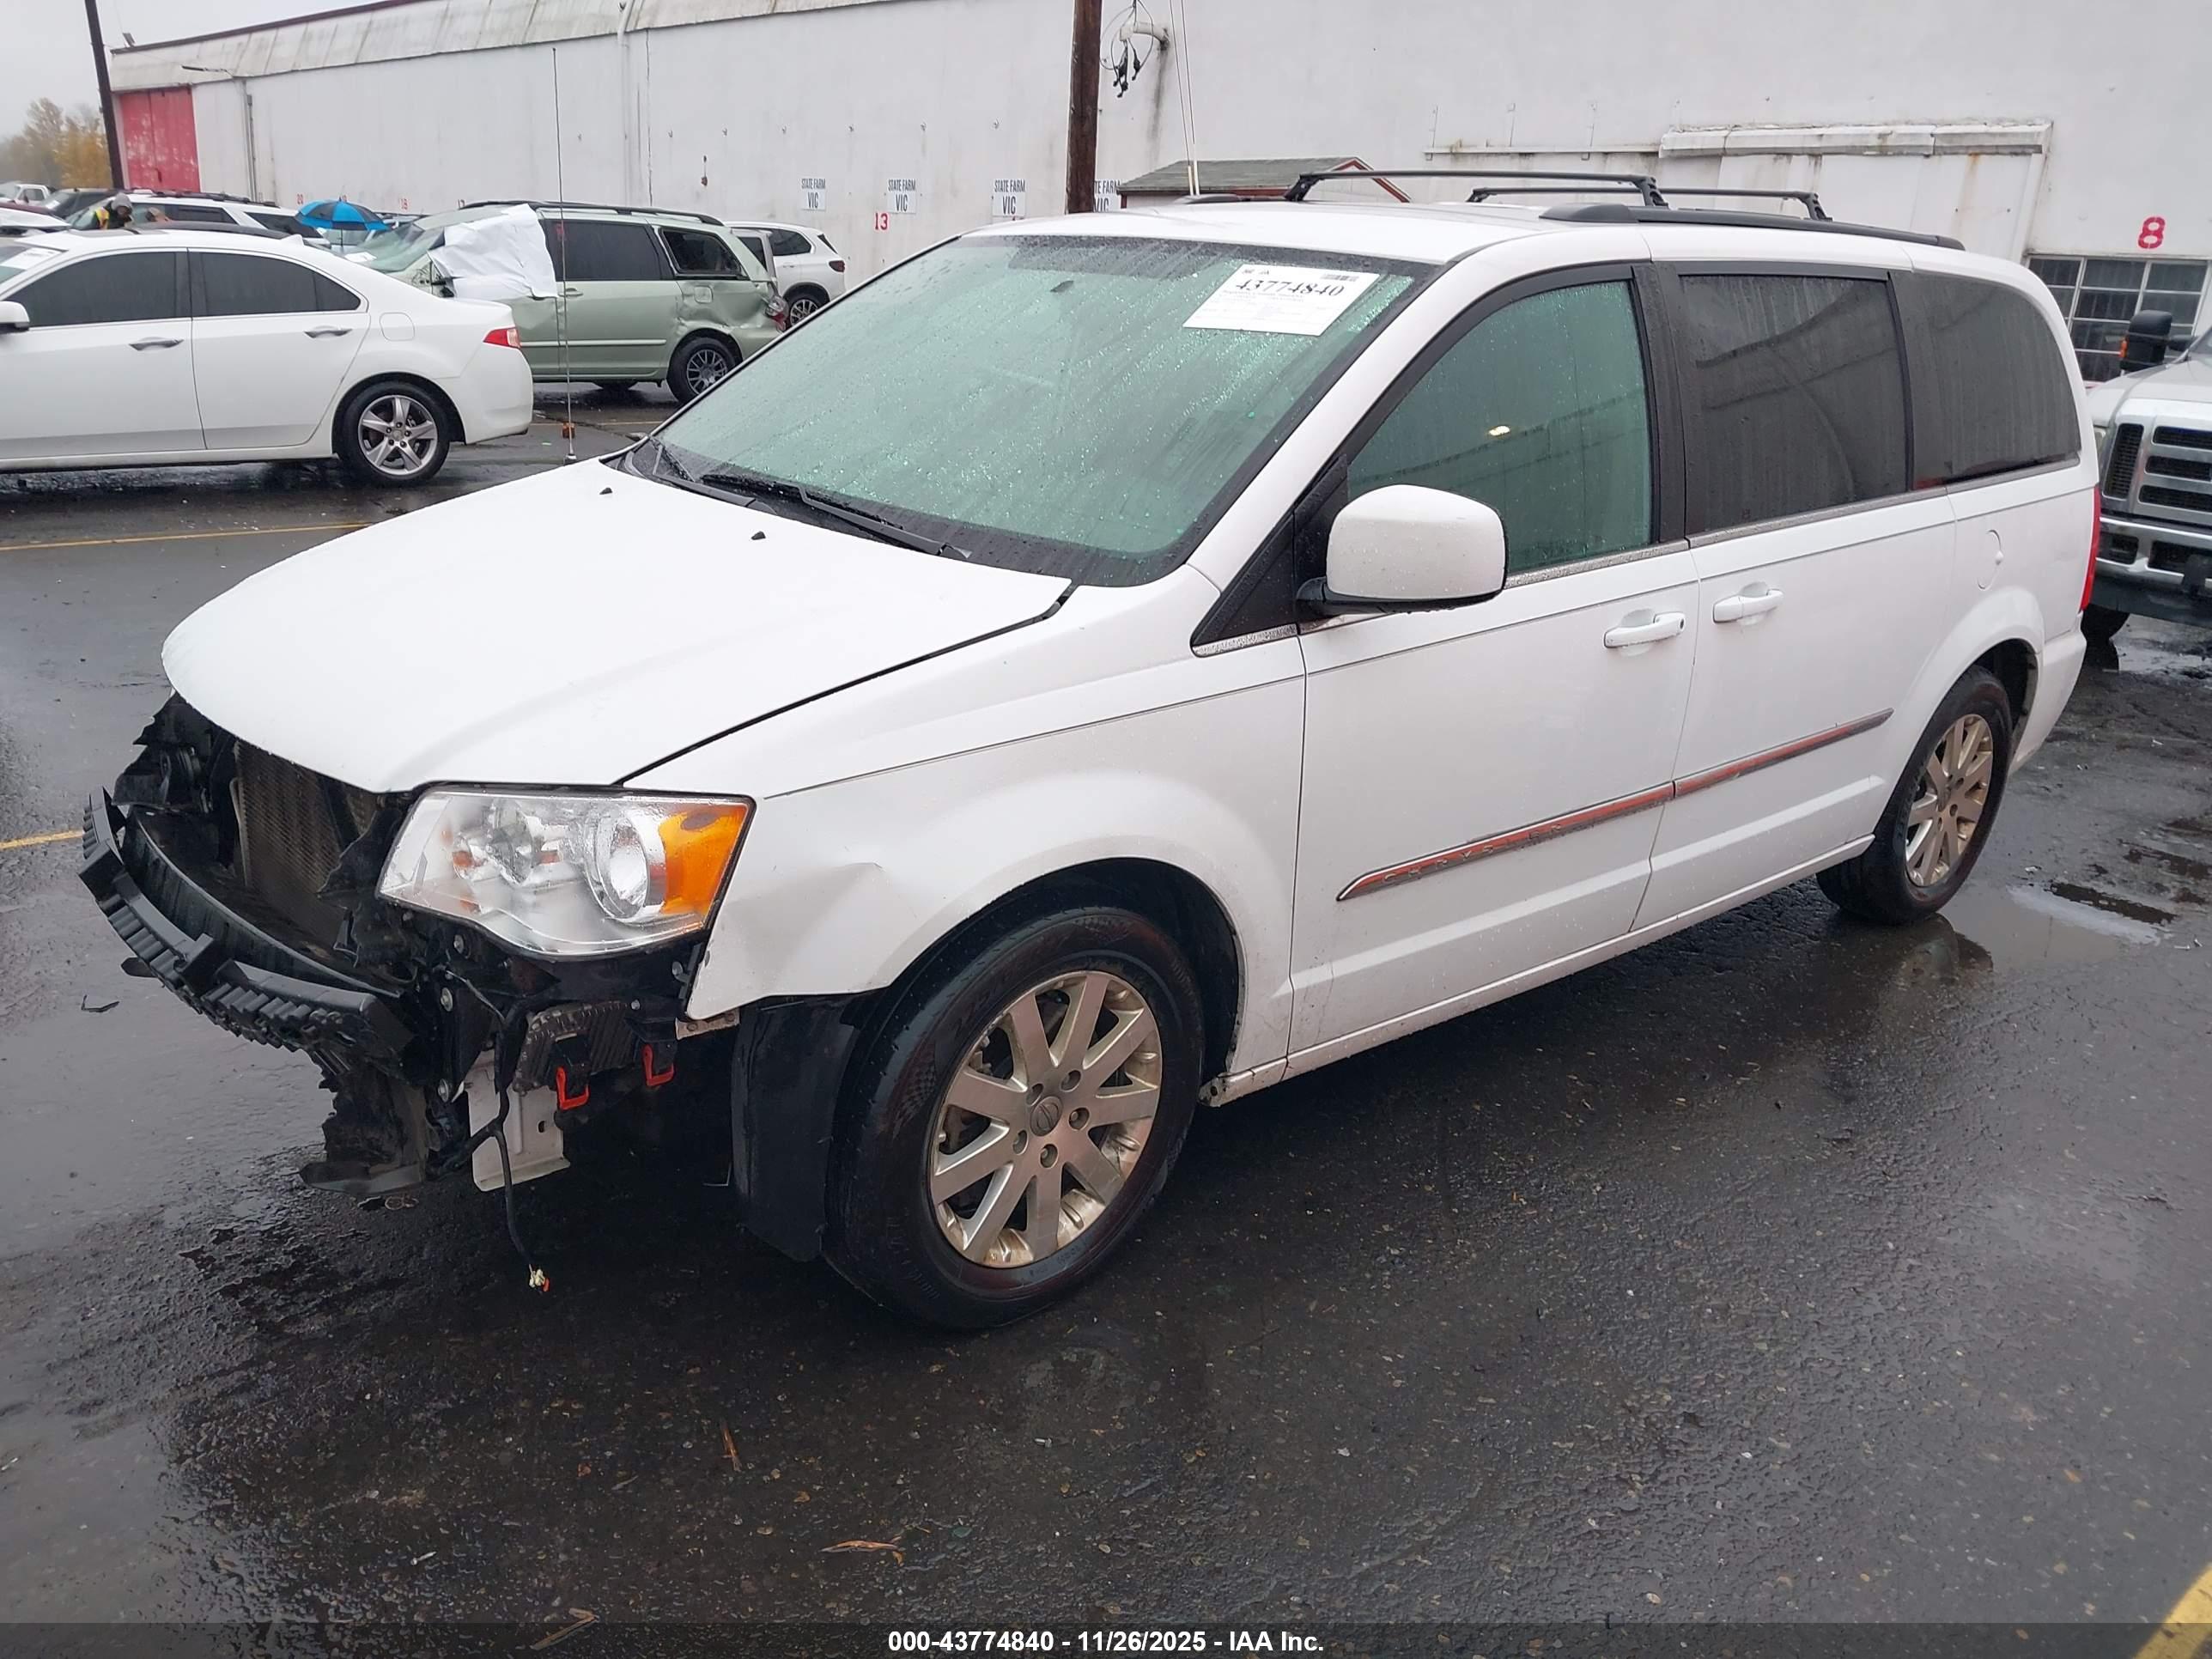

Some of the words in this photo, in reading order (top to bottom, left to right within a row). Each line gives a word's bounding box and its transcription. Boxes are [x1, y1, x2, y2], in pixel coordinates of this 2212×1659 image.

[801, 178, 813, 189] STATE
[813, 178, 826, 189] FARM
[888, 179, 902, 191] STATE
[902, 179, 916, 191] FARM
[994, 179, 1009, 193] STATE
[1010, 179, 1026, 193] FARM
[807, 191, 818, 209] VIC
[896, 193, 908, 212] VIC
[1002, 196, 1016, 215] VIC
[875, 212, 889, 231] 13
[2137, 216, 2166, 249] 8
[1236, 278, 1346, 297] 43774840
